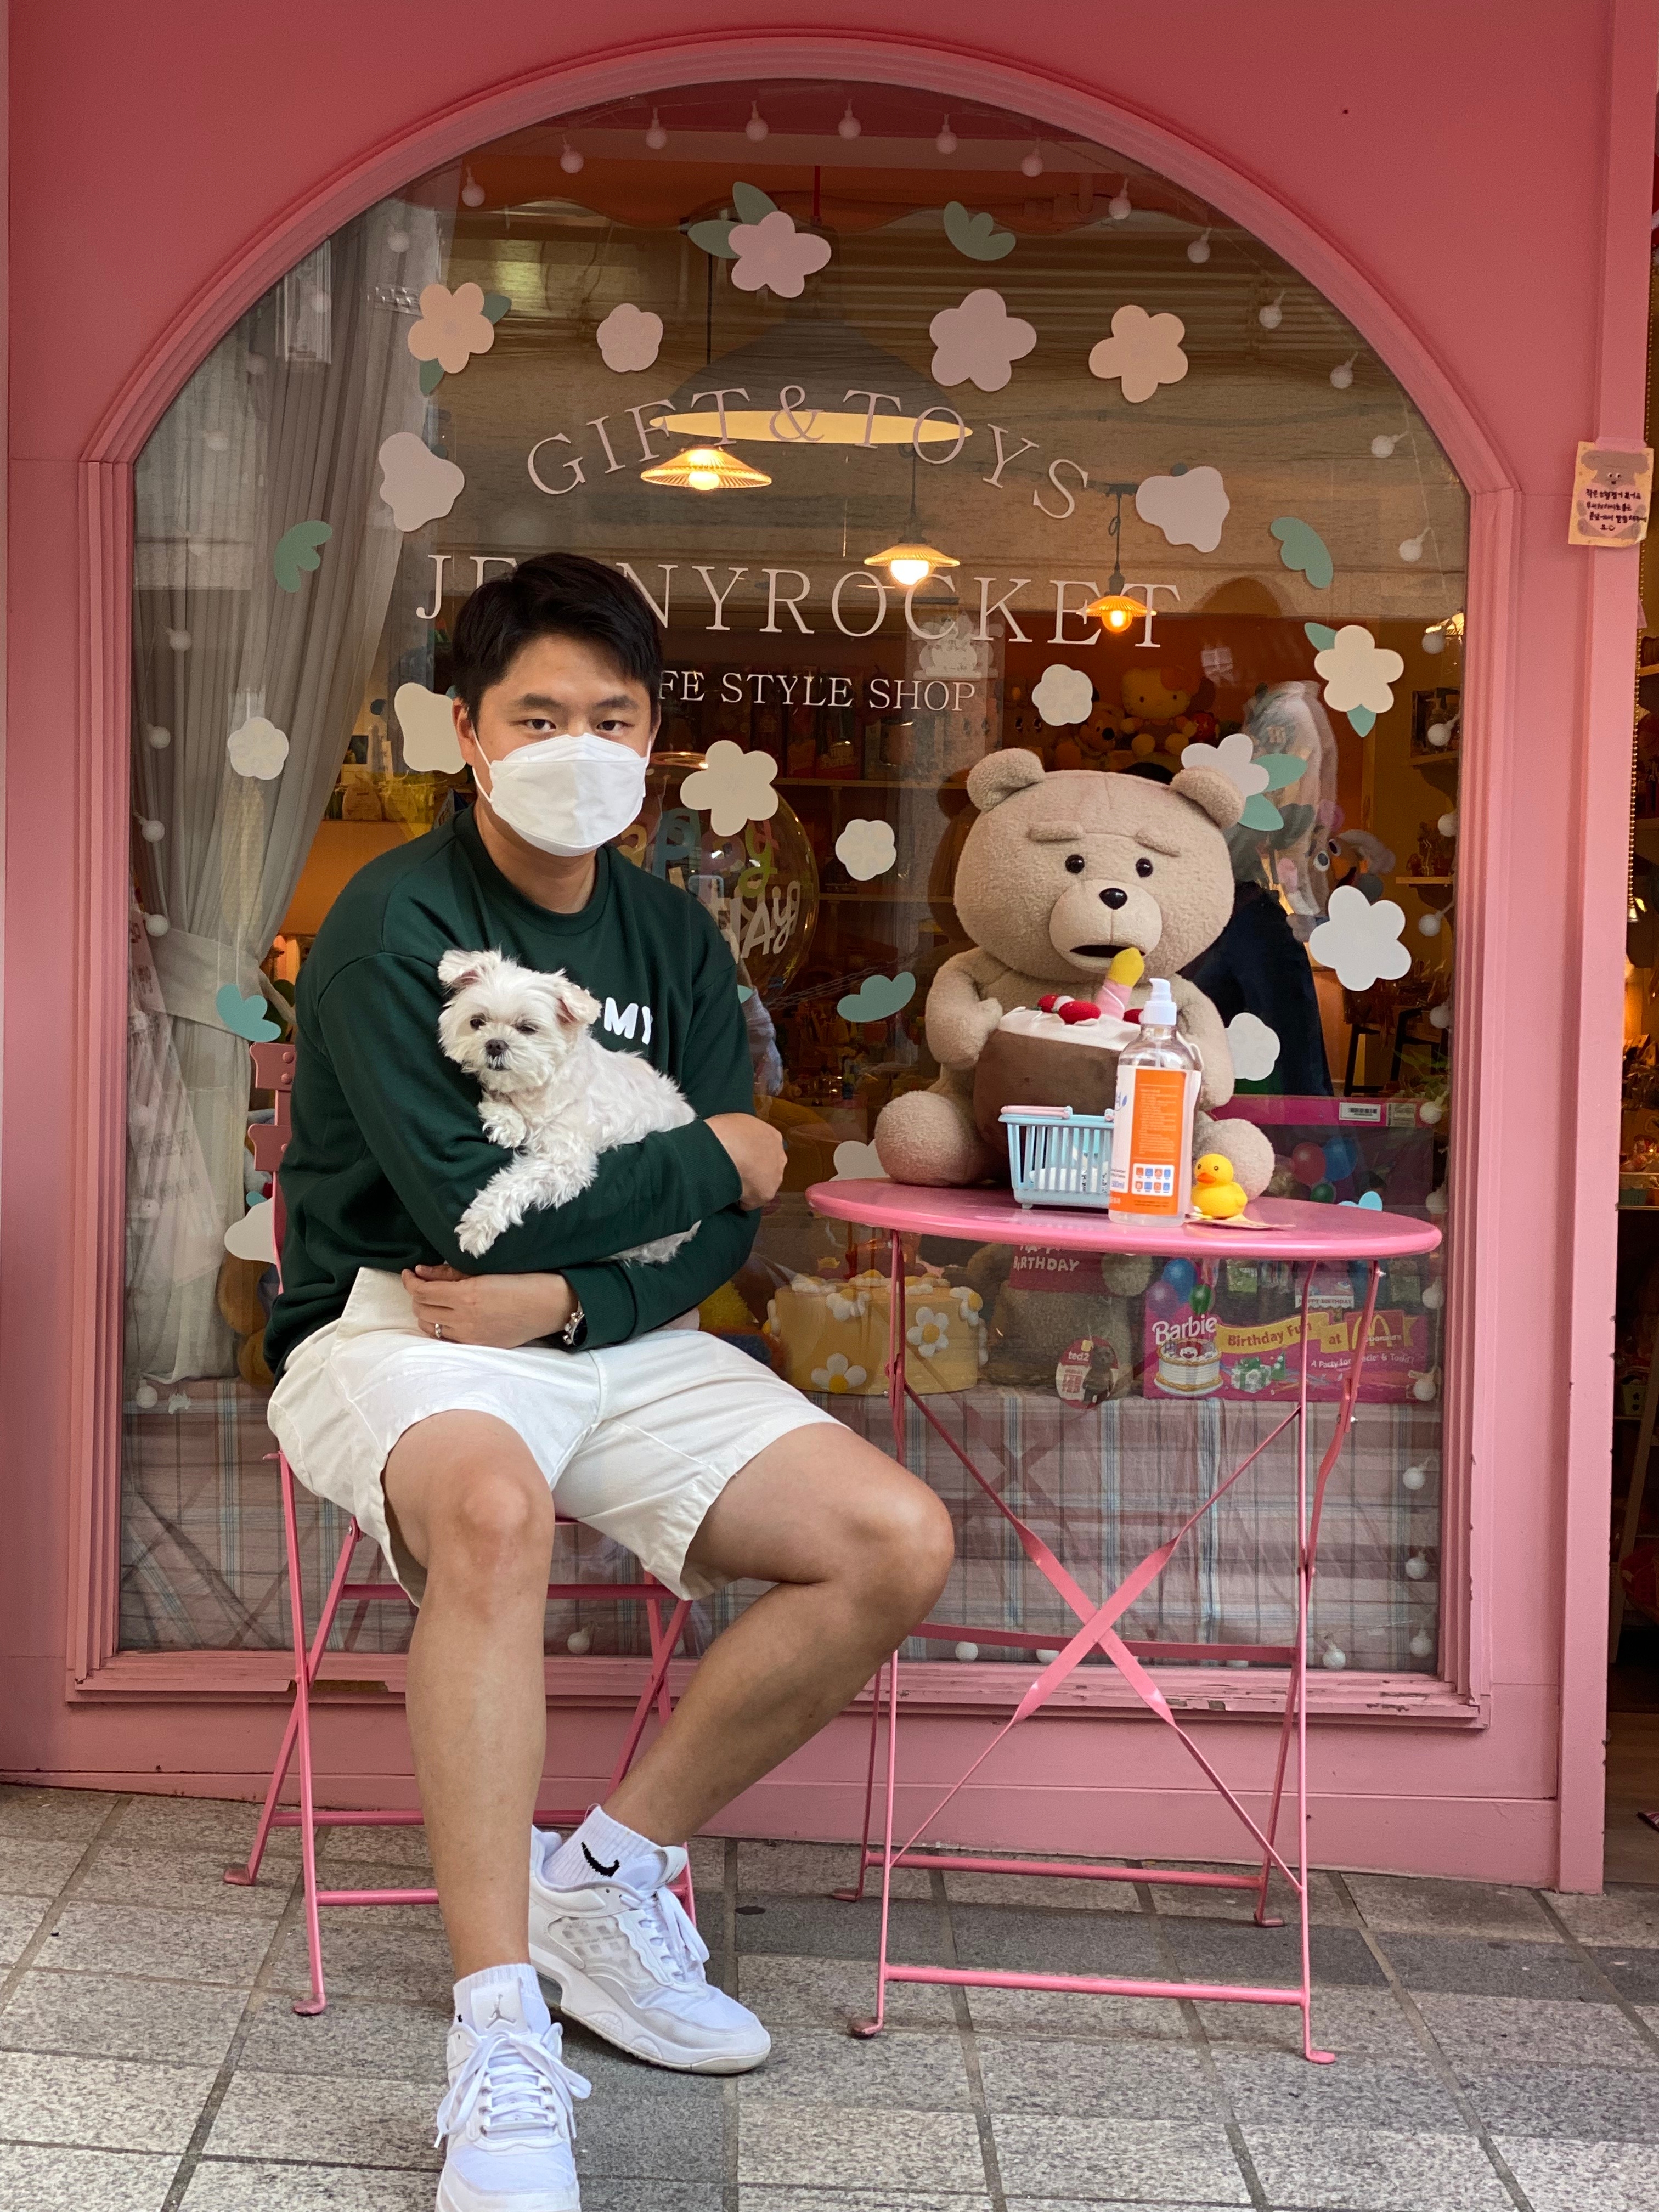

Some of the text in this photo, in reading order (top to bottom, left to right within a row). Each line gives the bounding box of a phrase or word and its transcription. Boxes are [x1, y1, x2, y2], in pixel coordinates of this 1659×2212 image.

[527, 385, 1089, 520] GIFT & TOYS
[416, 554, 1181, 648] JNYROCKET
[659, 670, 975, 712] FE STYLE SHOP
[1152, 1314, 1218, 1345] Barbie
[1228, 1328, 1284, 1347] Birthday
[1328, 1333, 1342, 1345] at
